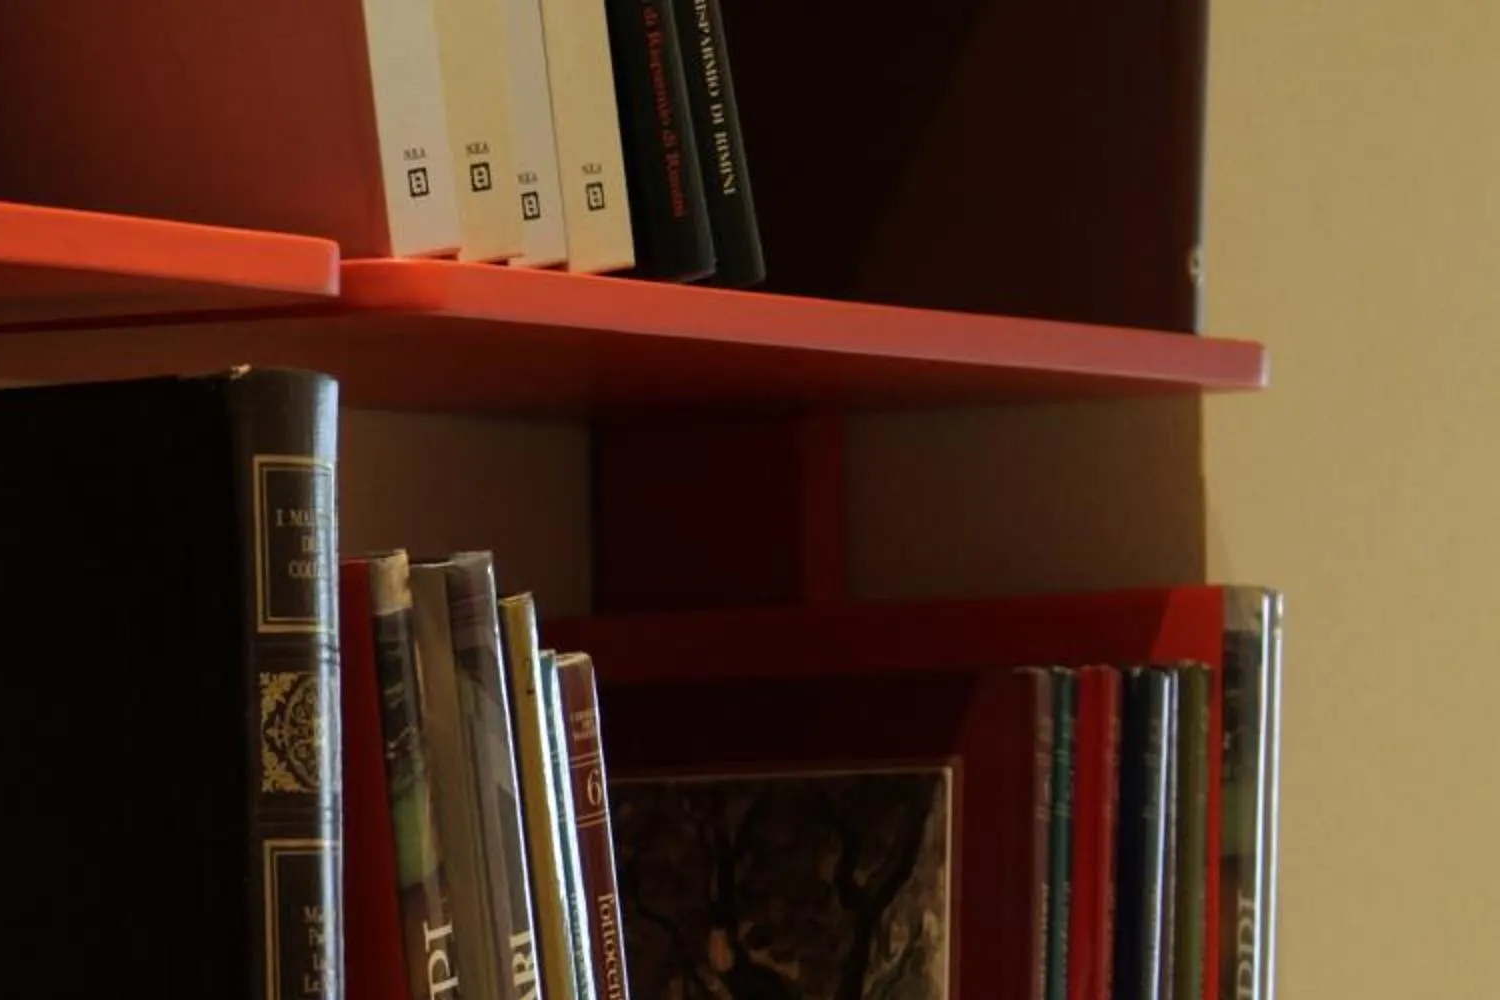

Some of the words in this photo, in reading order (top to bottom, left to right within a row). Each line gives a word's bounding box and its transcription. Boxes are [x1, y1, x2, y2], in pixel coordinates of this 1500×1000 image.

[708, 103, 726, 126] DI
[713, 130, 737, 197] RIMINI
[586, 767, 603, 807] 6
